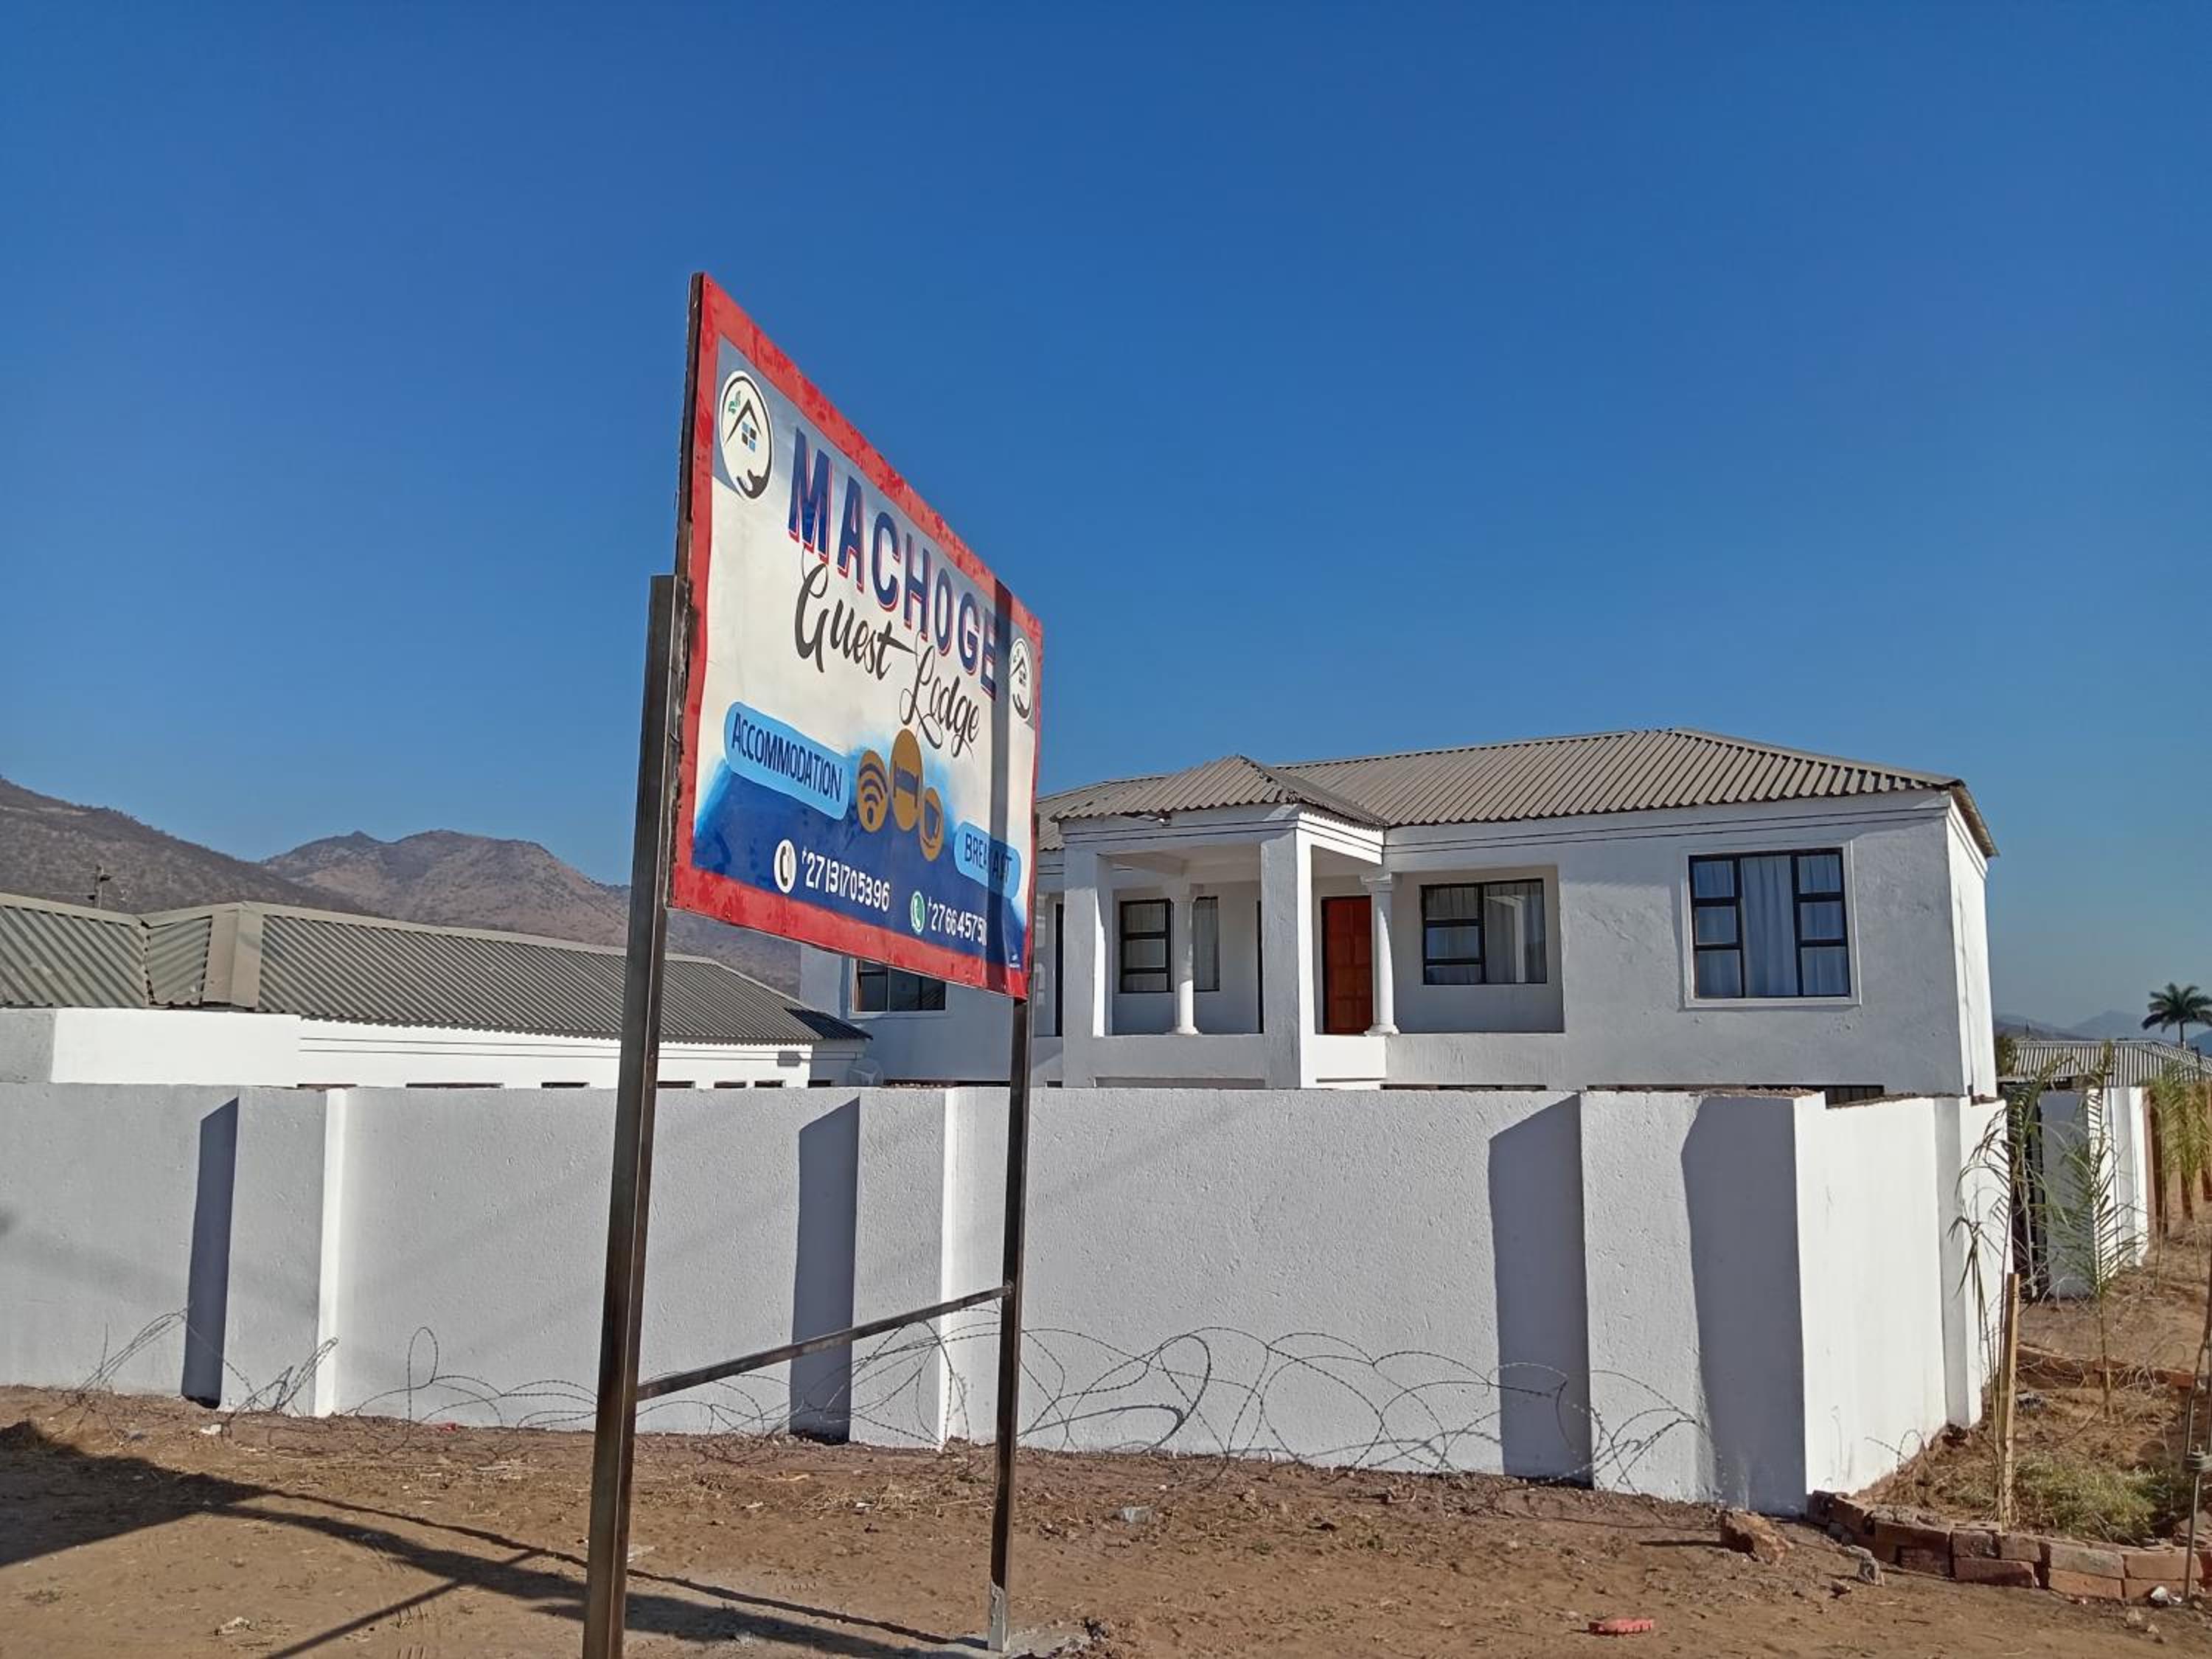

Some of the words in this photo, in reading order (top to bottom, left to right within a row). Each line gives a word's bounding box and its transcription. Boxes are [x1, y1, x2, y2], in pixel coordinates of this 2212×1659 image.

[787, 425, 995, 701] MACHOGE
[795, 546, 919, 681] Guest
[900, 630, 980, 760] Lodge
[731, 712, 843, 803] ACCOMMODATION
